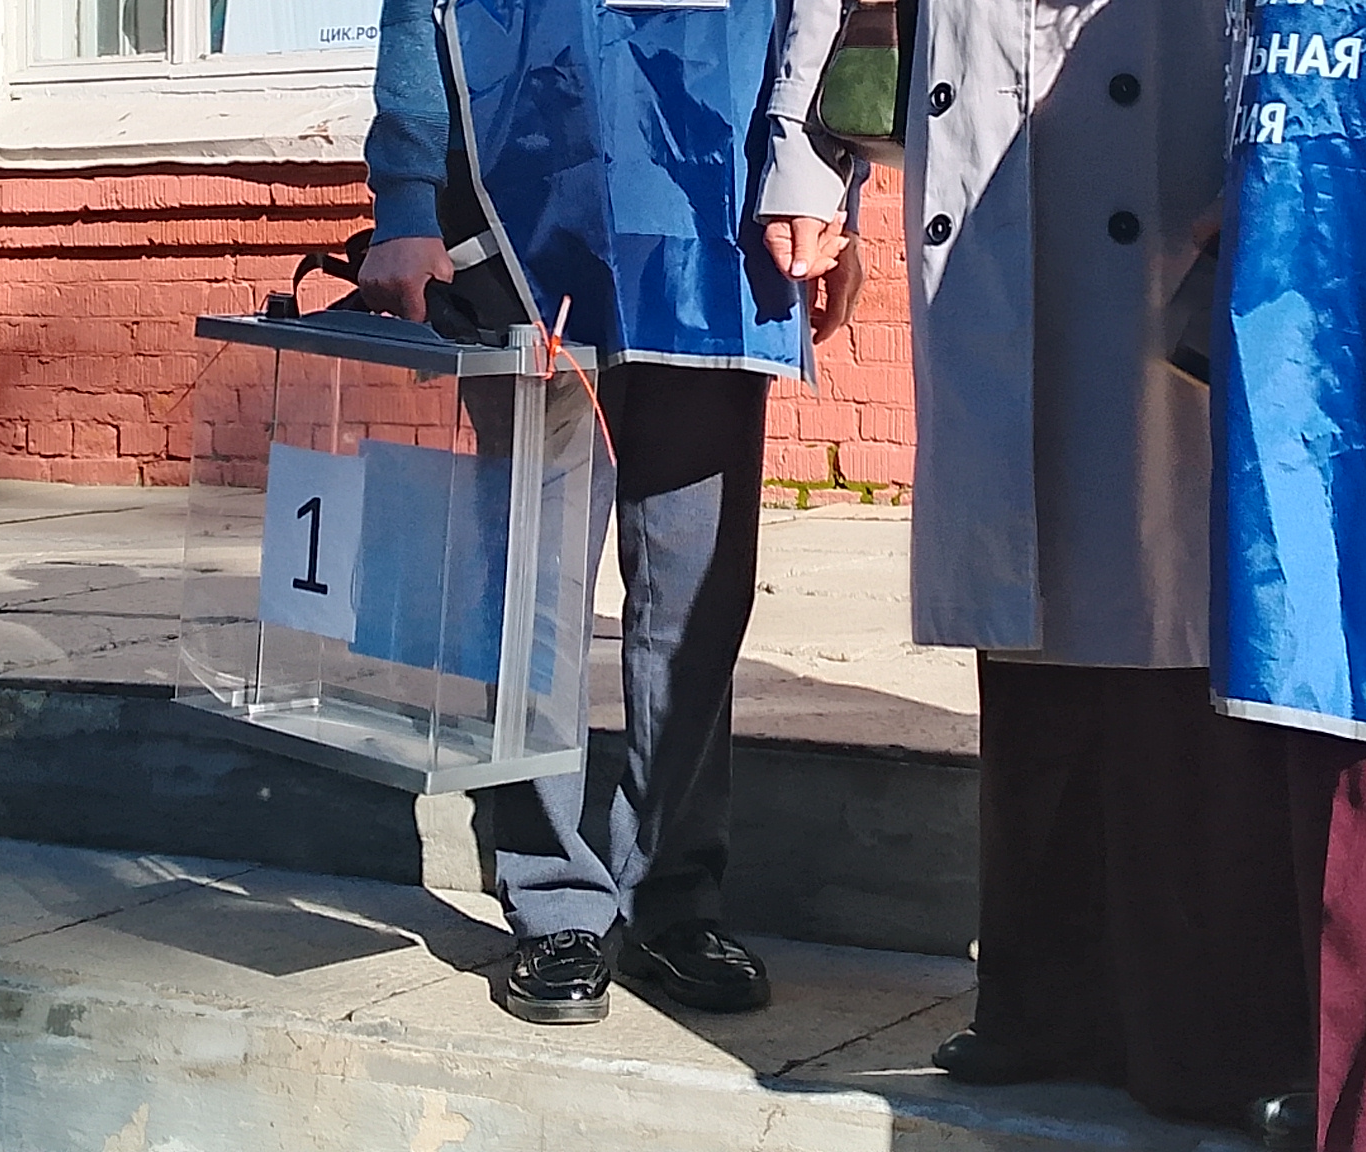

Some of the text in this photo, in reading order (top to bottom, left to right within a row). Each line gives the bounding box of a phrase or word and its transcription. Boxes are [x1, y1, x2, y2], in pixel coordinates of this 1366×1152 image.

[319, 26, 378, 44] ЦИК.РФ
[1236, 102, 1287, 144] ИЯ
[292, 496, 329, 596] 1
